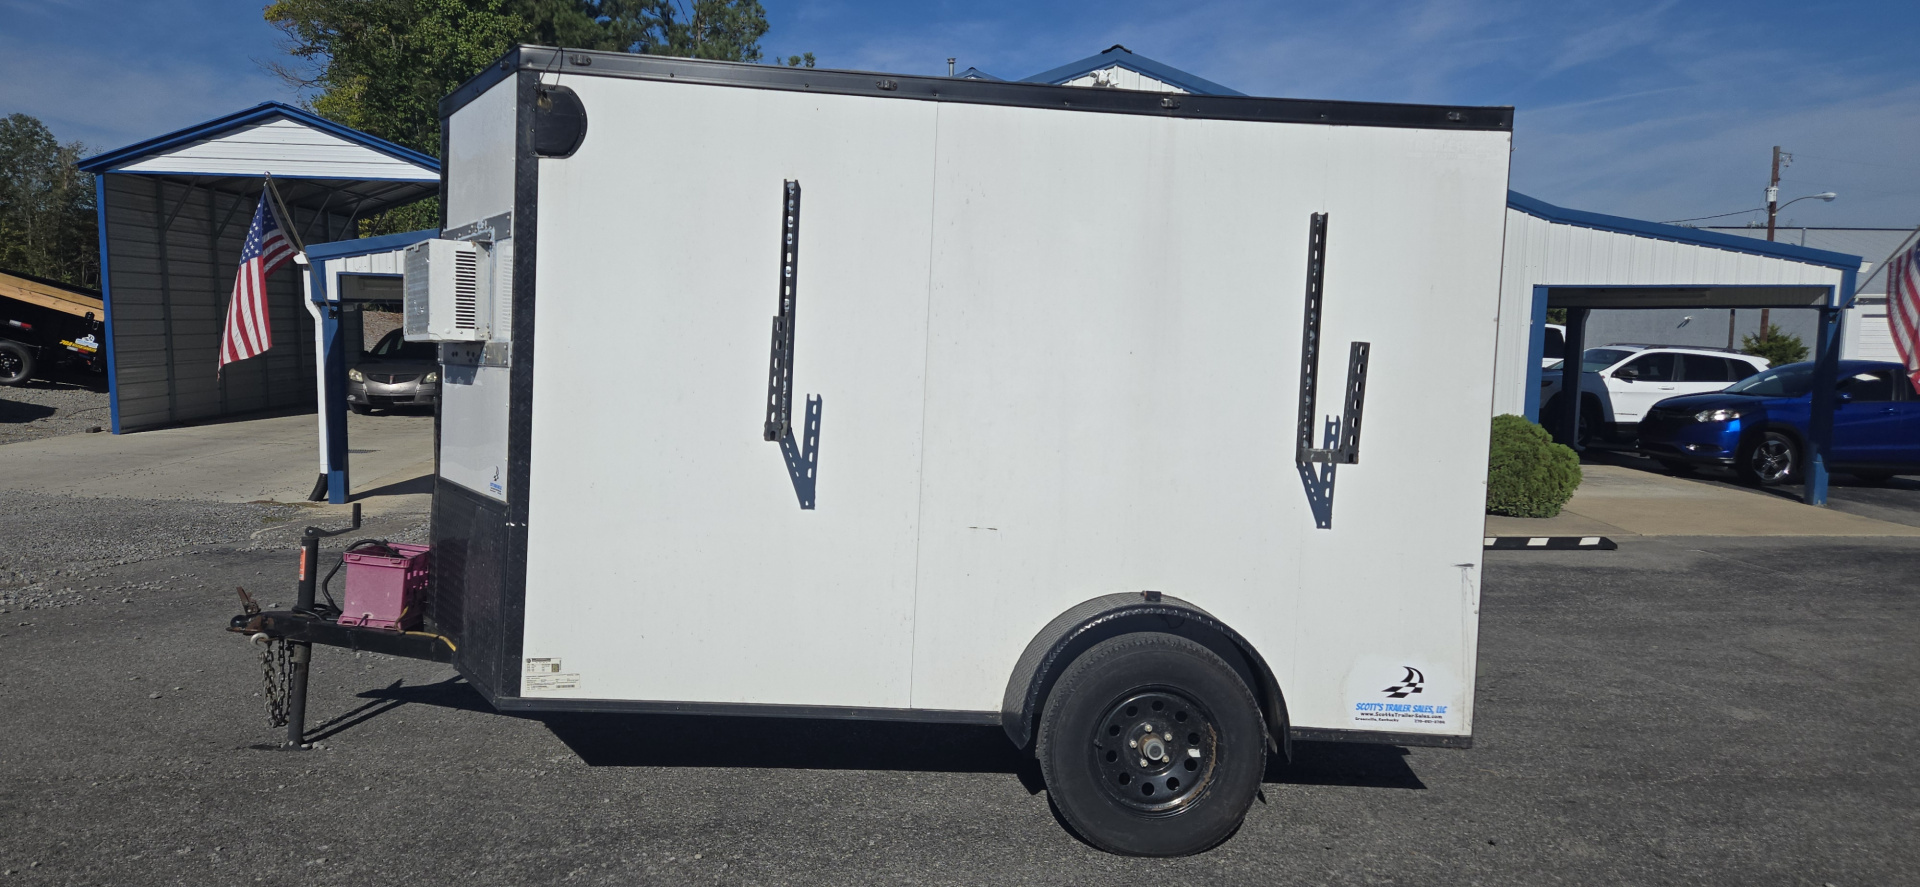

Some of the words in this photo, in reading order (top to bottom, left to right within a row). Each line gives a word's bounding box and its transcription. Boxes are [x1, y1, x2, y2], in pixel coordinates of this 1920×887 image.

[1355, 702, 1384, 711] SCOTT'S
[1385, 704, 1411, 712] TRAILER
[1412, 705, 1434, 714] SALES,
[1436, 706, 1447, 714] LLC
